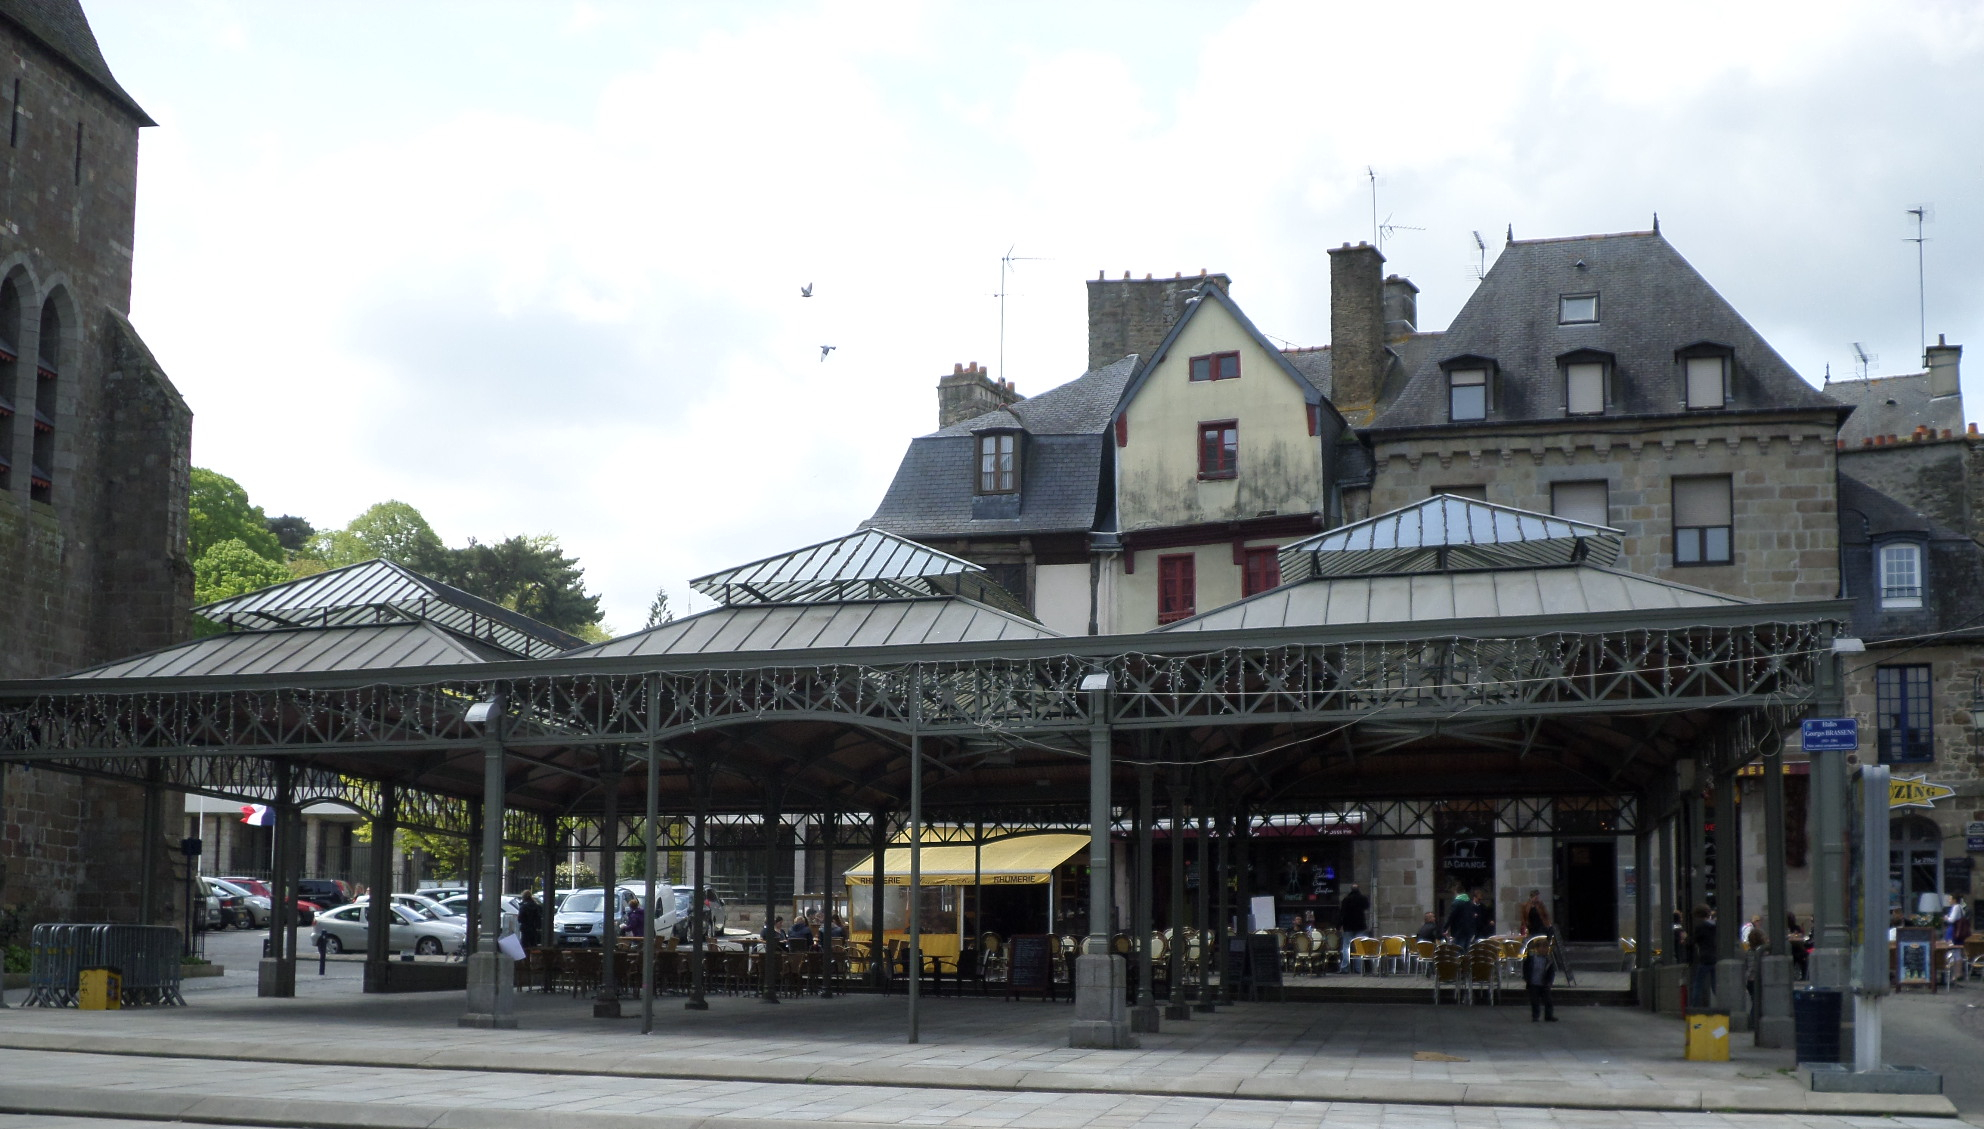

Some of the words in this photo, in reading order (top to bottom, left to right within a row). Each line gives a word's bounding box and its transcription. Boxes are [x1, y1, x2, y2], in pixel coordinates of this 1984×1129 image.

[1805, 730, 1825, 738] Georges
[1894, 784, 1936, 799] ZING
[860, 876, 902, 885] RHERIE
[993, 875, 1036, 884] RHUMERIE
